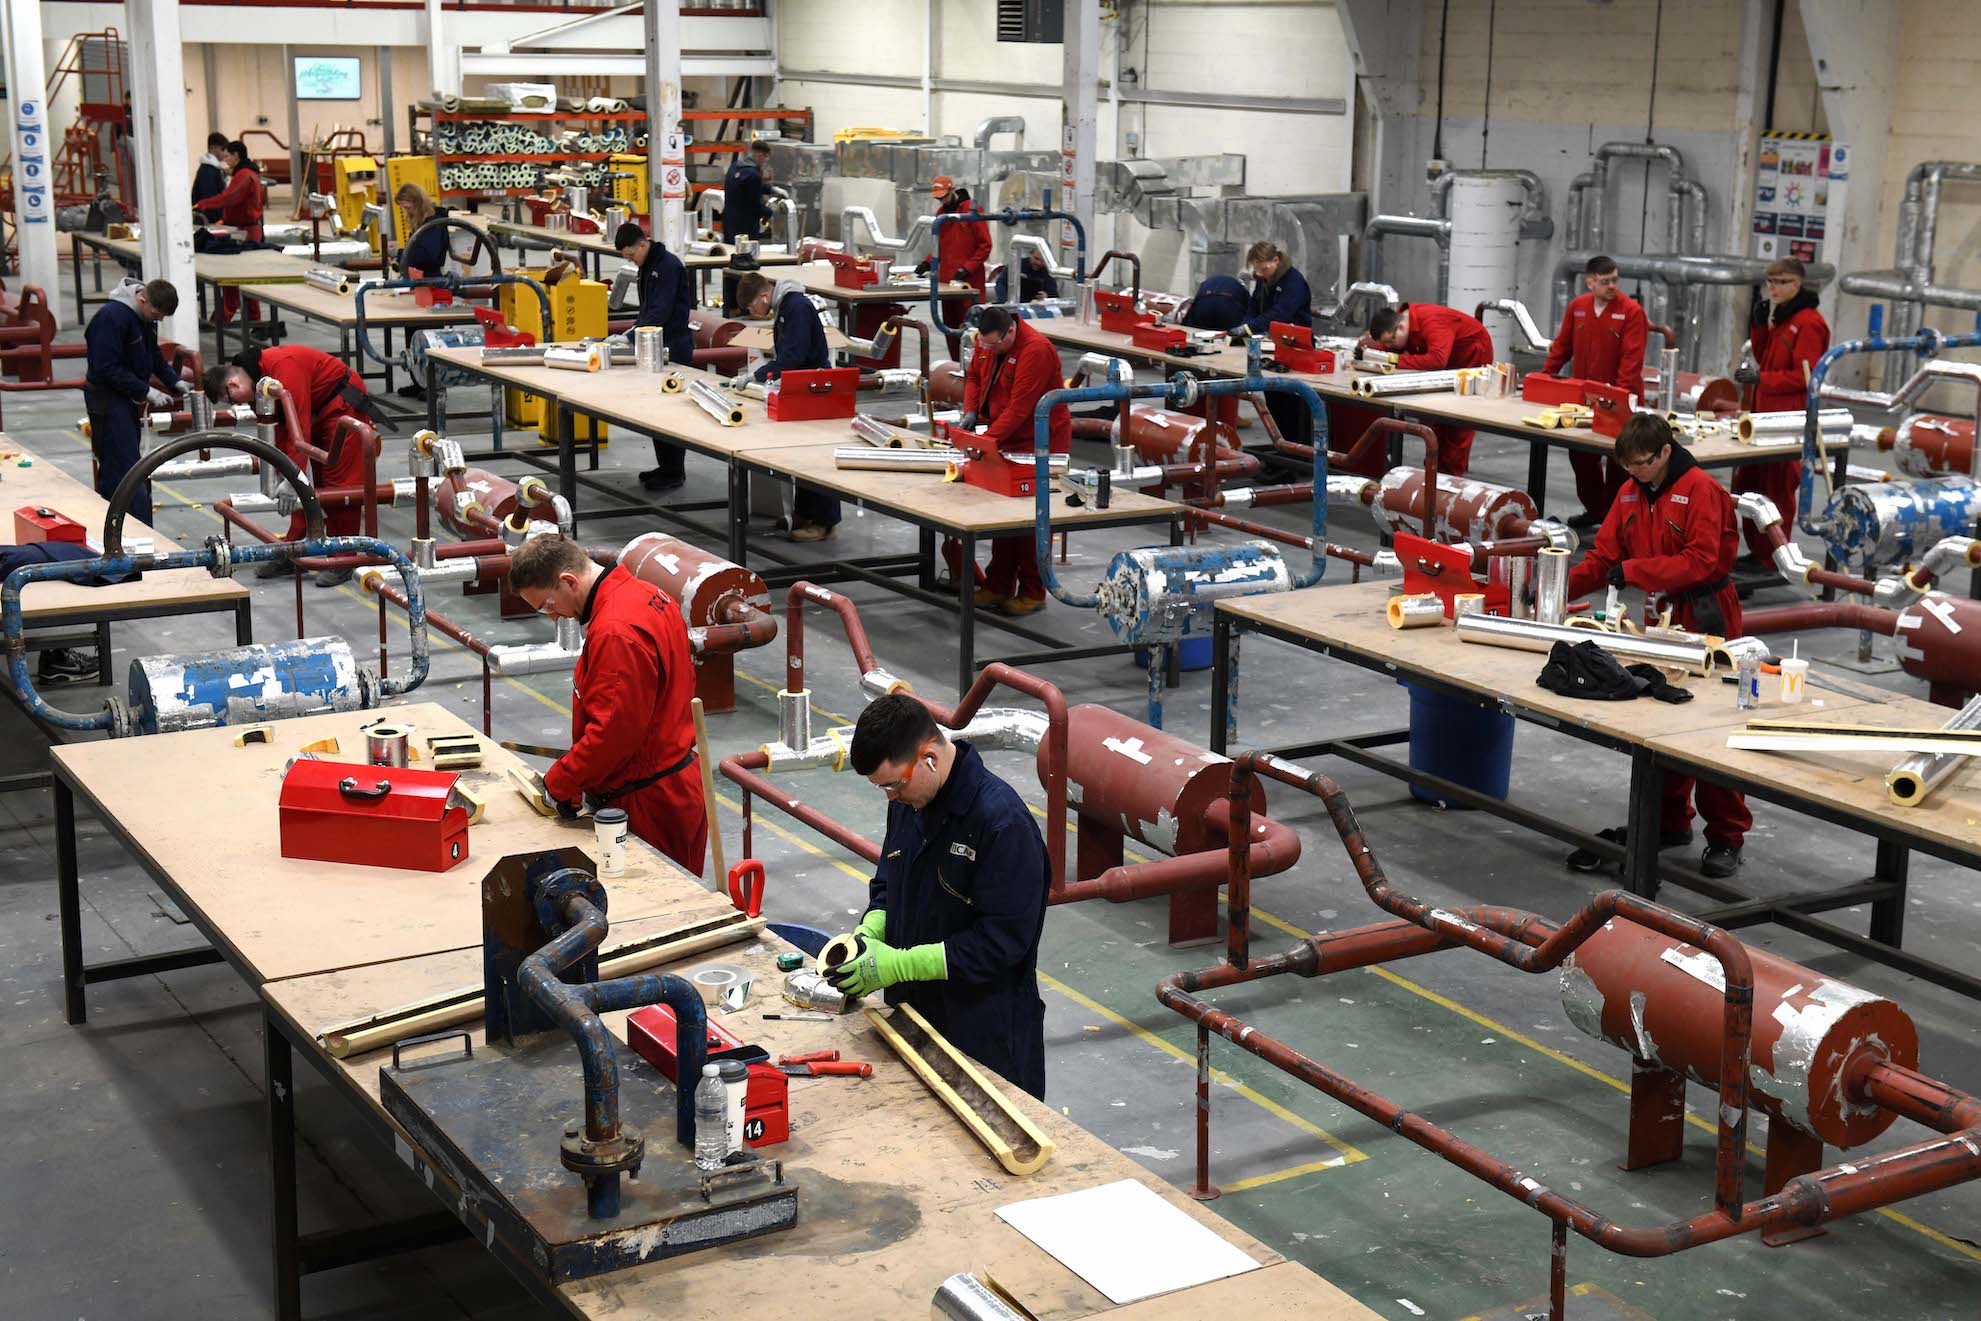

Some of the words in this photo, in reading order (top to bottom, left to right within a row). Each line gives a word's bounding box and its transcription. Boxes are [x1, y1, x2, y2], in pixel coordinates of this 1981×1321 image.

[1020, 483, 1029, 491] 10
[452, 843, 458, 857] 4
[745, 1121, 763, 1138] 14
